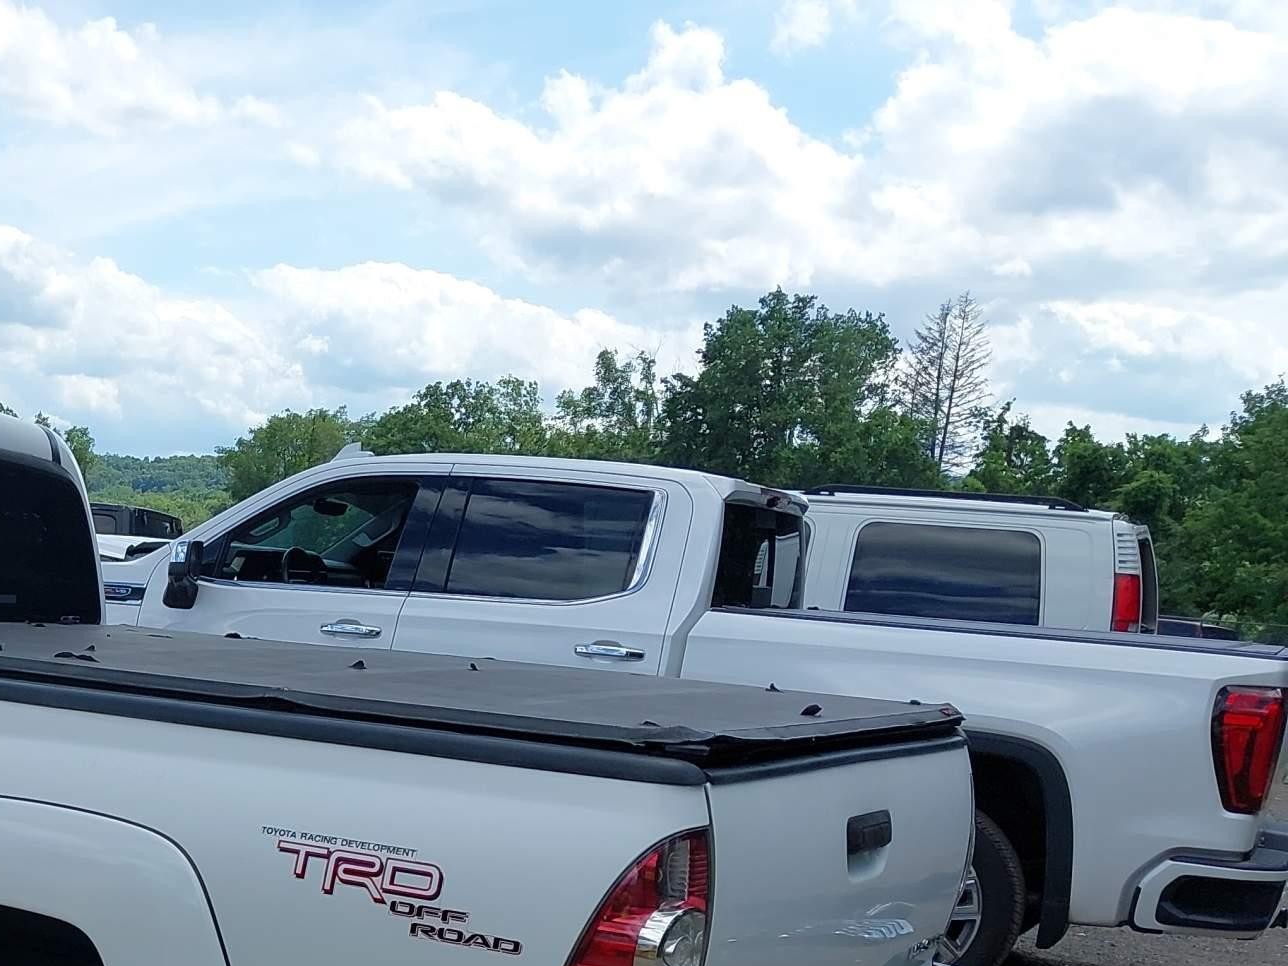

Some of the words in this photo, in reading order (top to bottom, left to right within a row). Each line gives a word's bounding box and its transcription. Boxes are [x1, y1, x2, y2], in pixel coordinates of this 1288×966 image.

[261, 826, 297, 839] TOYOTA
[300, 832, 338, 846] RACING
[340, 838, 417, 858] DEVELOPMENT
[277, 839, 445, 904] TRD
[388, 900, 470, 924] OFF
[409, 922, 524, 956] ROAD
